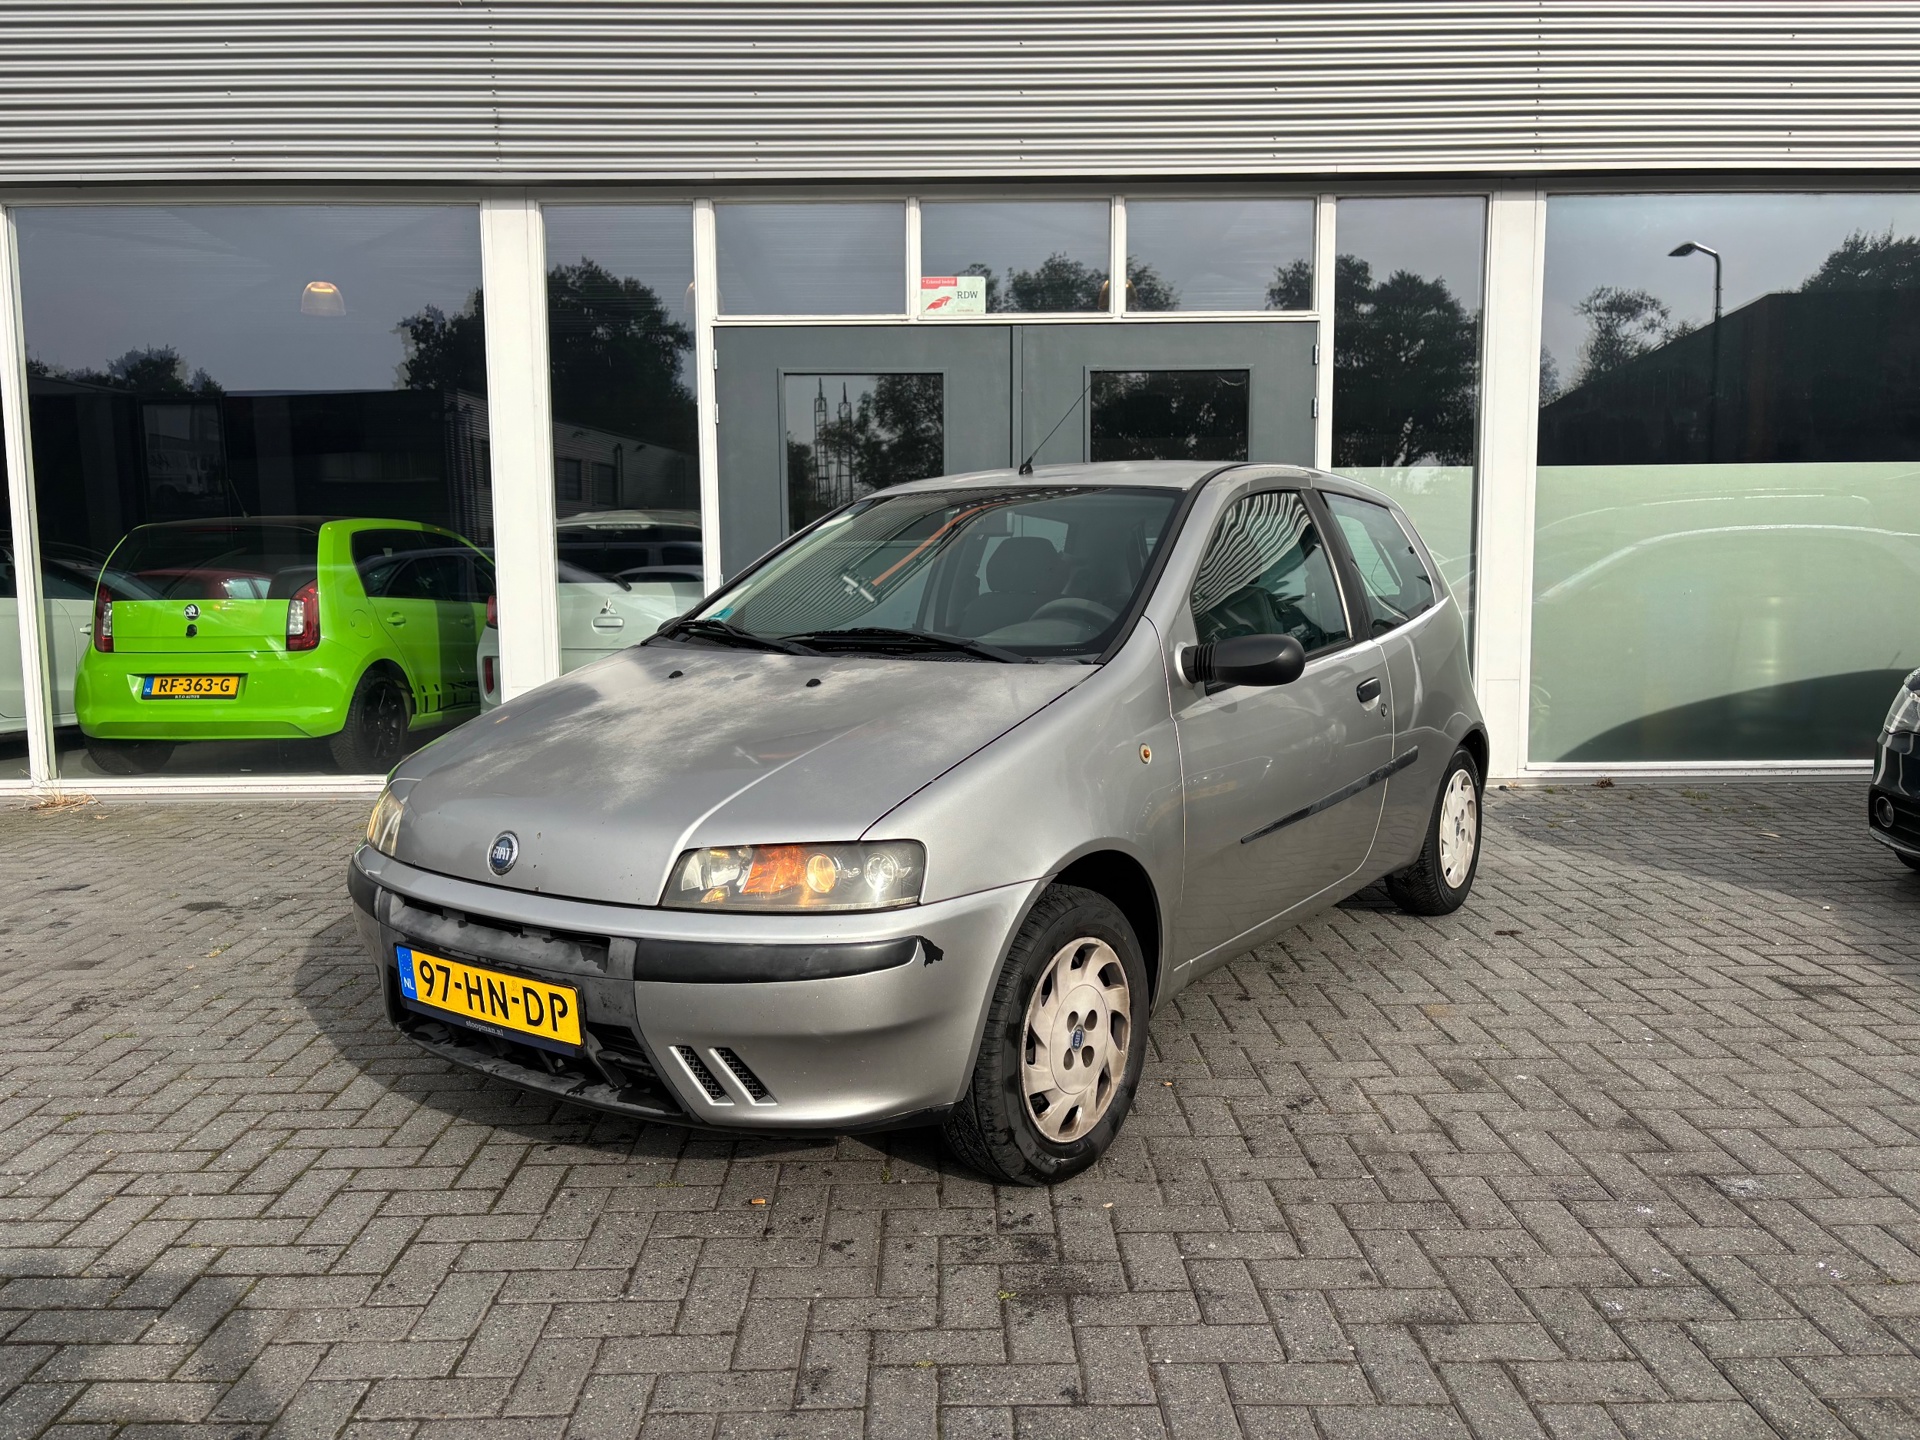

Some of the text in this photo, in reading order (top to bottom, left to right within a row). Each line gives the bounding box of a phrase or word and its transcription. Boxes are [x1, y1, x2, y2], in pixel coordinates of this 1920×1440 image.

[957, 291, 978, 299] RDW
[158, 678, 230, 692] RF-363-G
[492, 846, 512, 860] FIAT
[403, 977, 415, 991] NL
[419, 960, 569, 1033] 97-HN-DP
[465, 1020, 504, 1037] stoopman.nl
